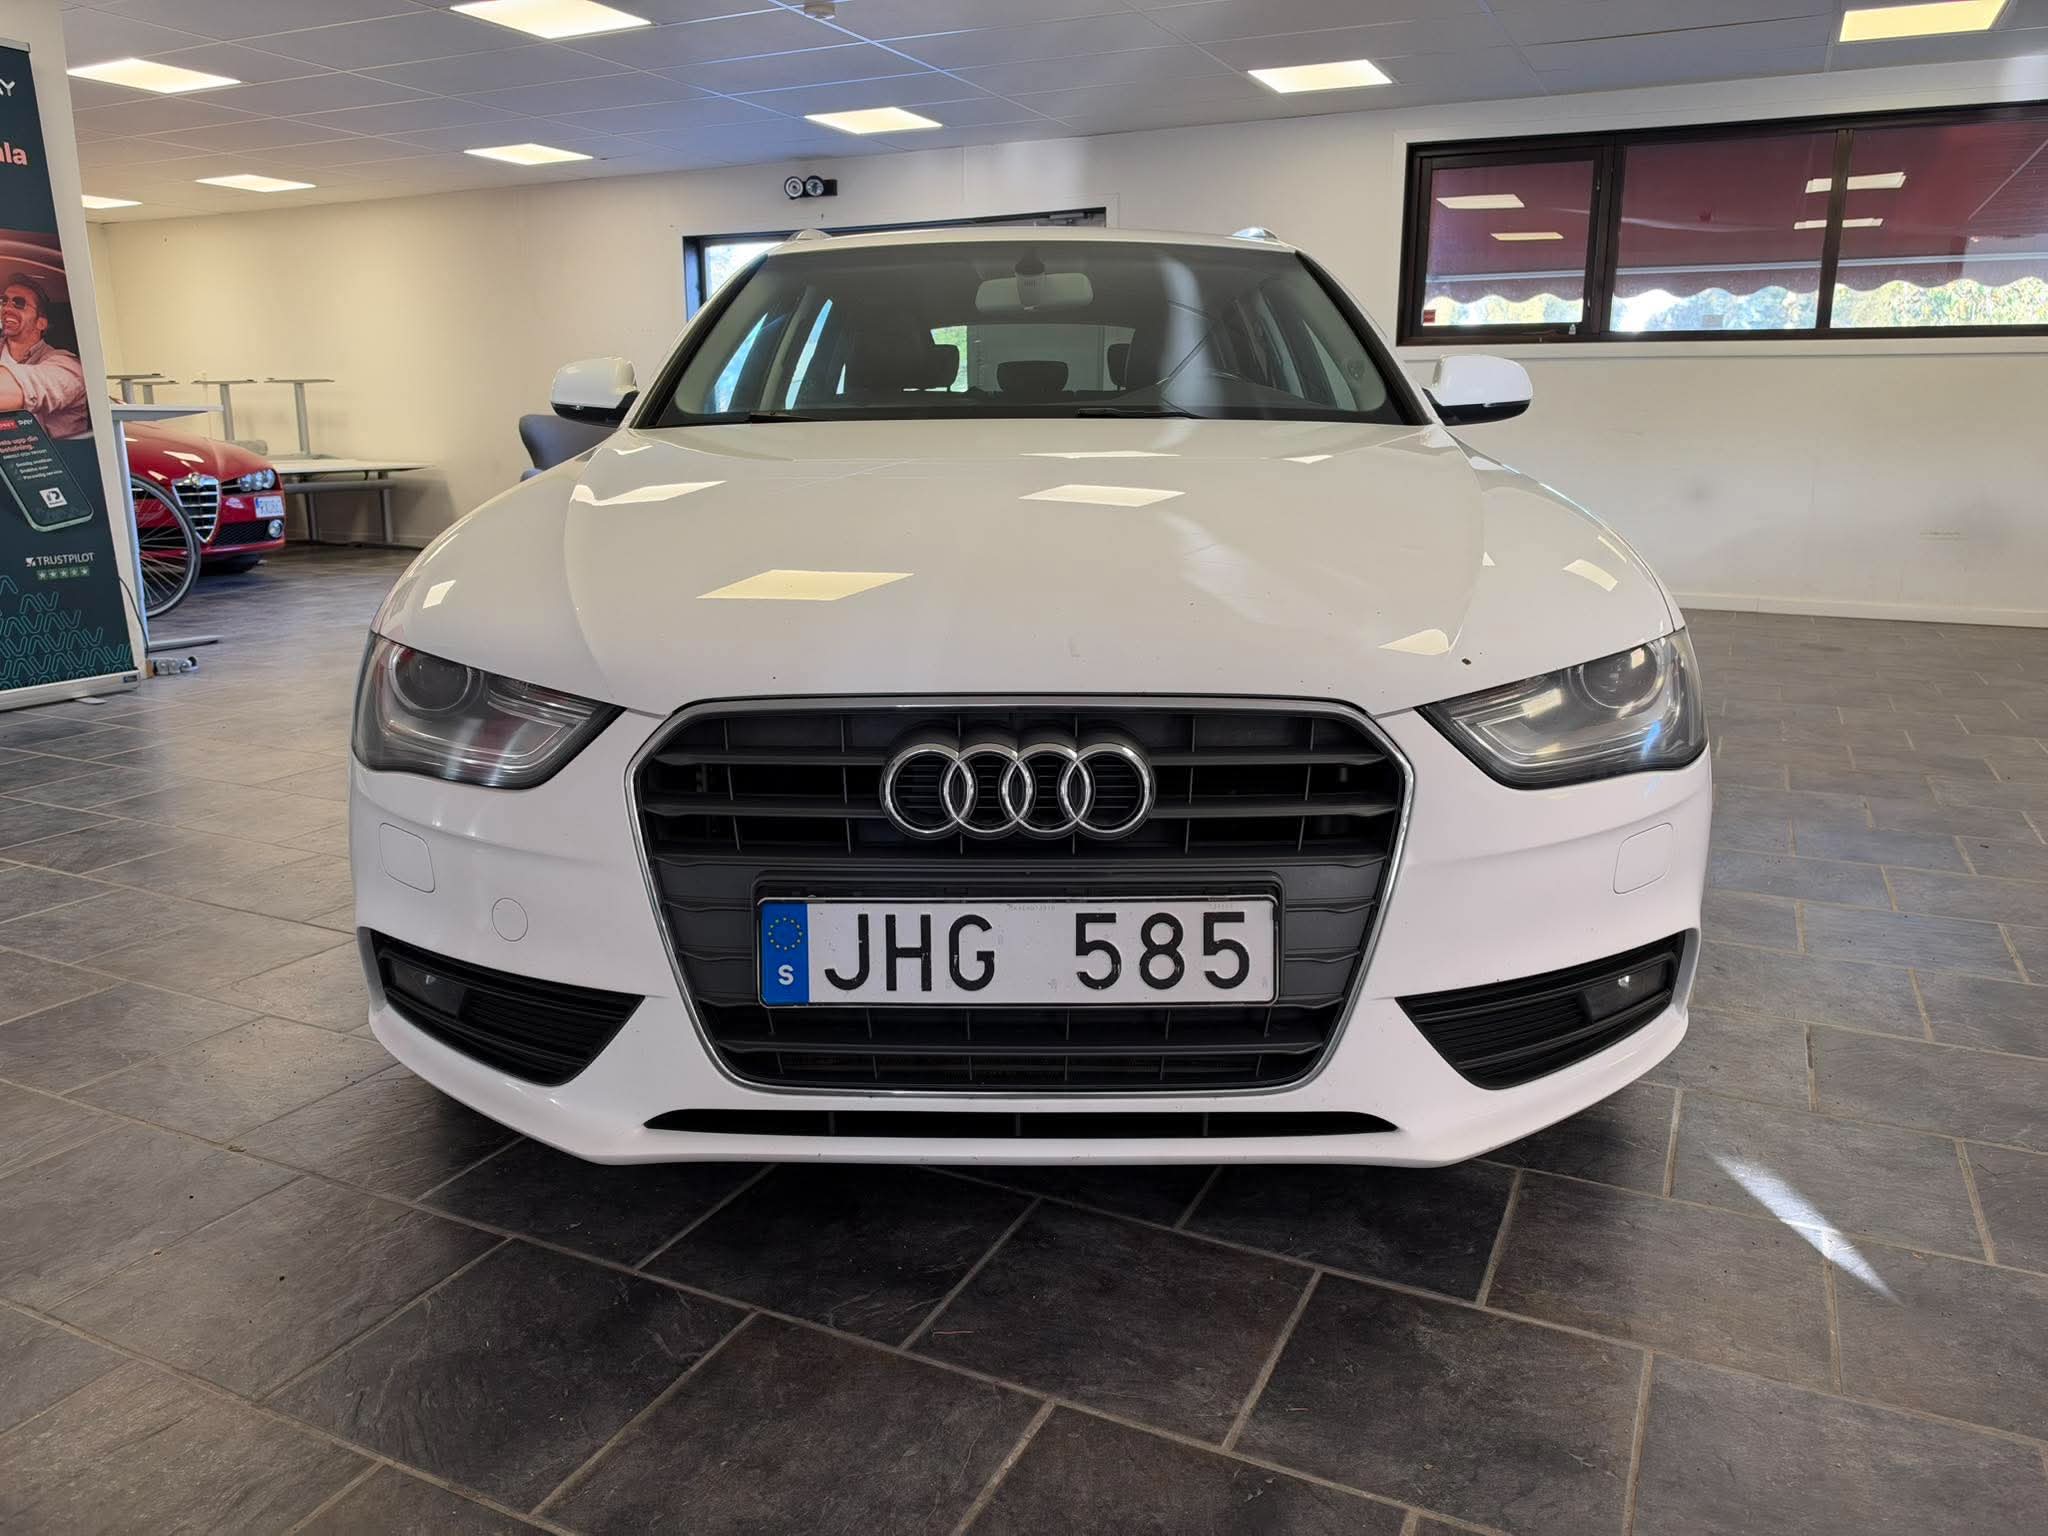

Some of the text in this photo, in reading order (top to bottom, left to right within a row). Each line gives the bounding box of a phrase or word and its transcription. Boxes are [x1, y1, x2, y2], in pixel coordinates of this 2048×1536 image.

[36, 552, 95, 566] TRUSTPILOT
[824, 911, 1251, 992] JHG 585
[778, 964, 795, 986] S
